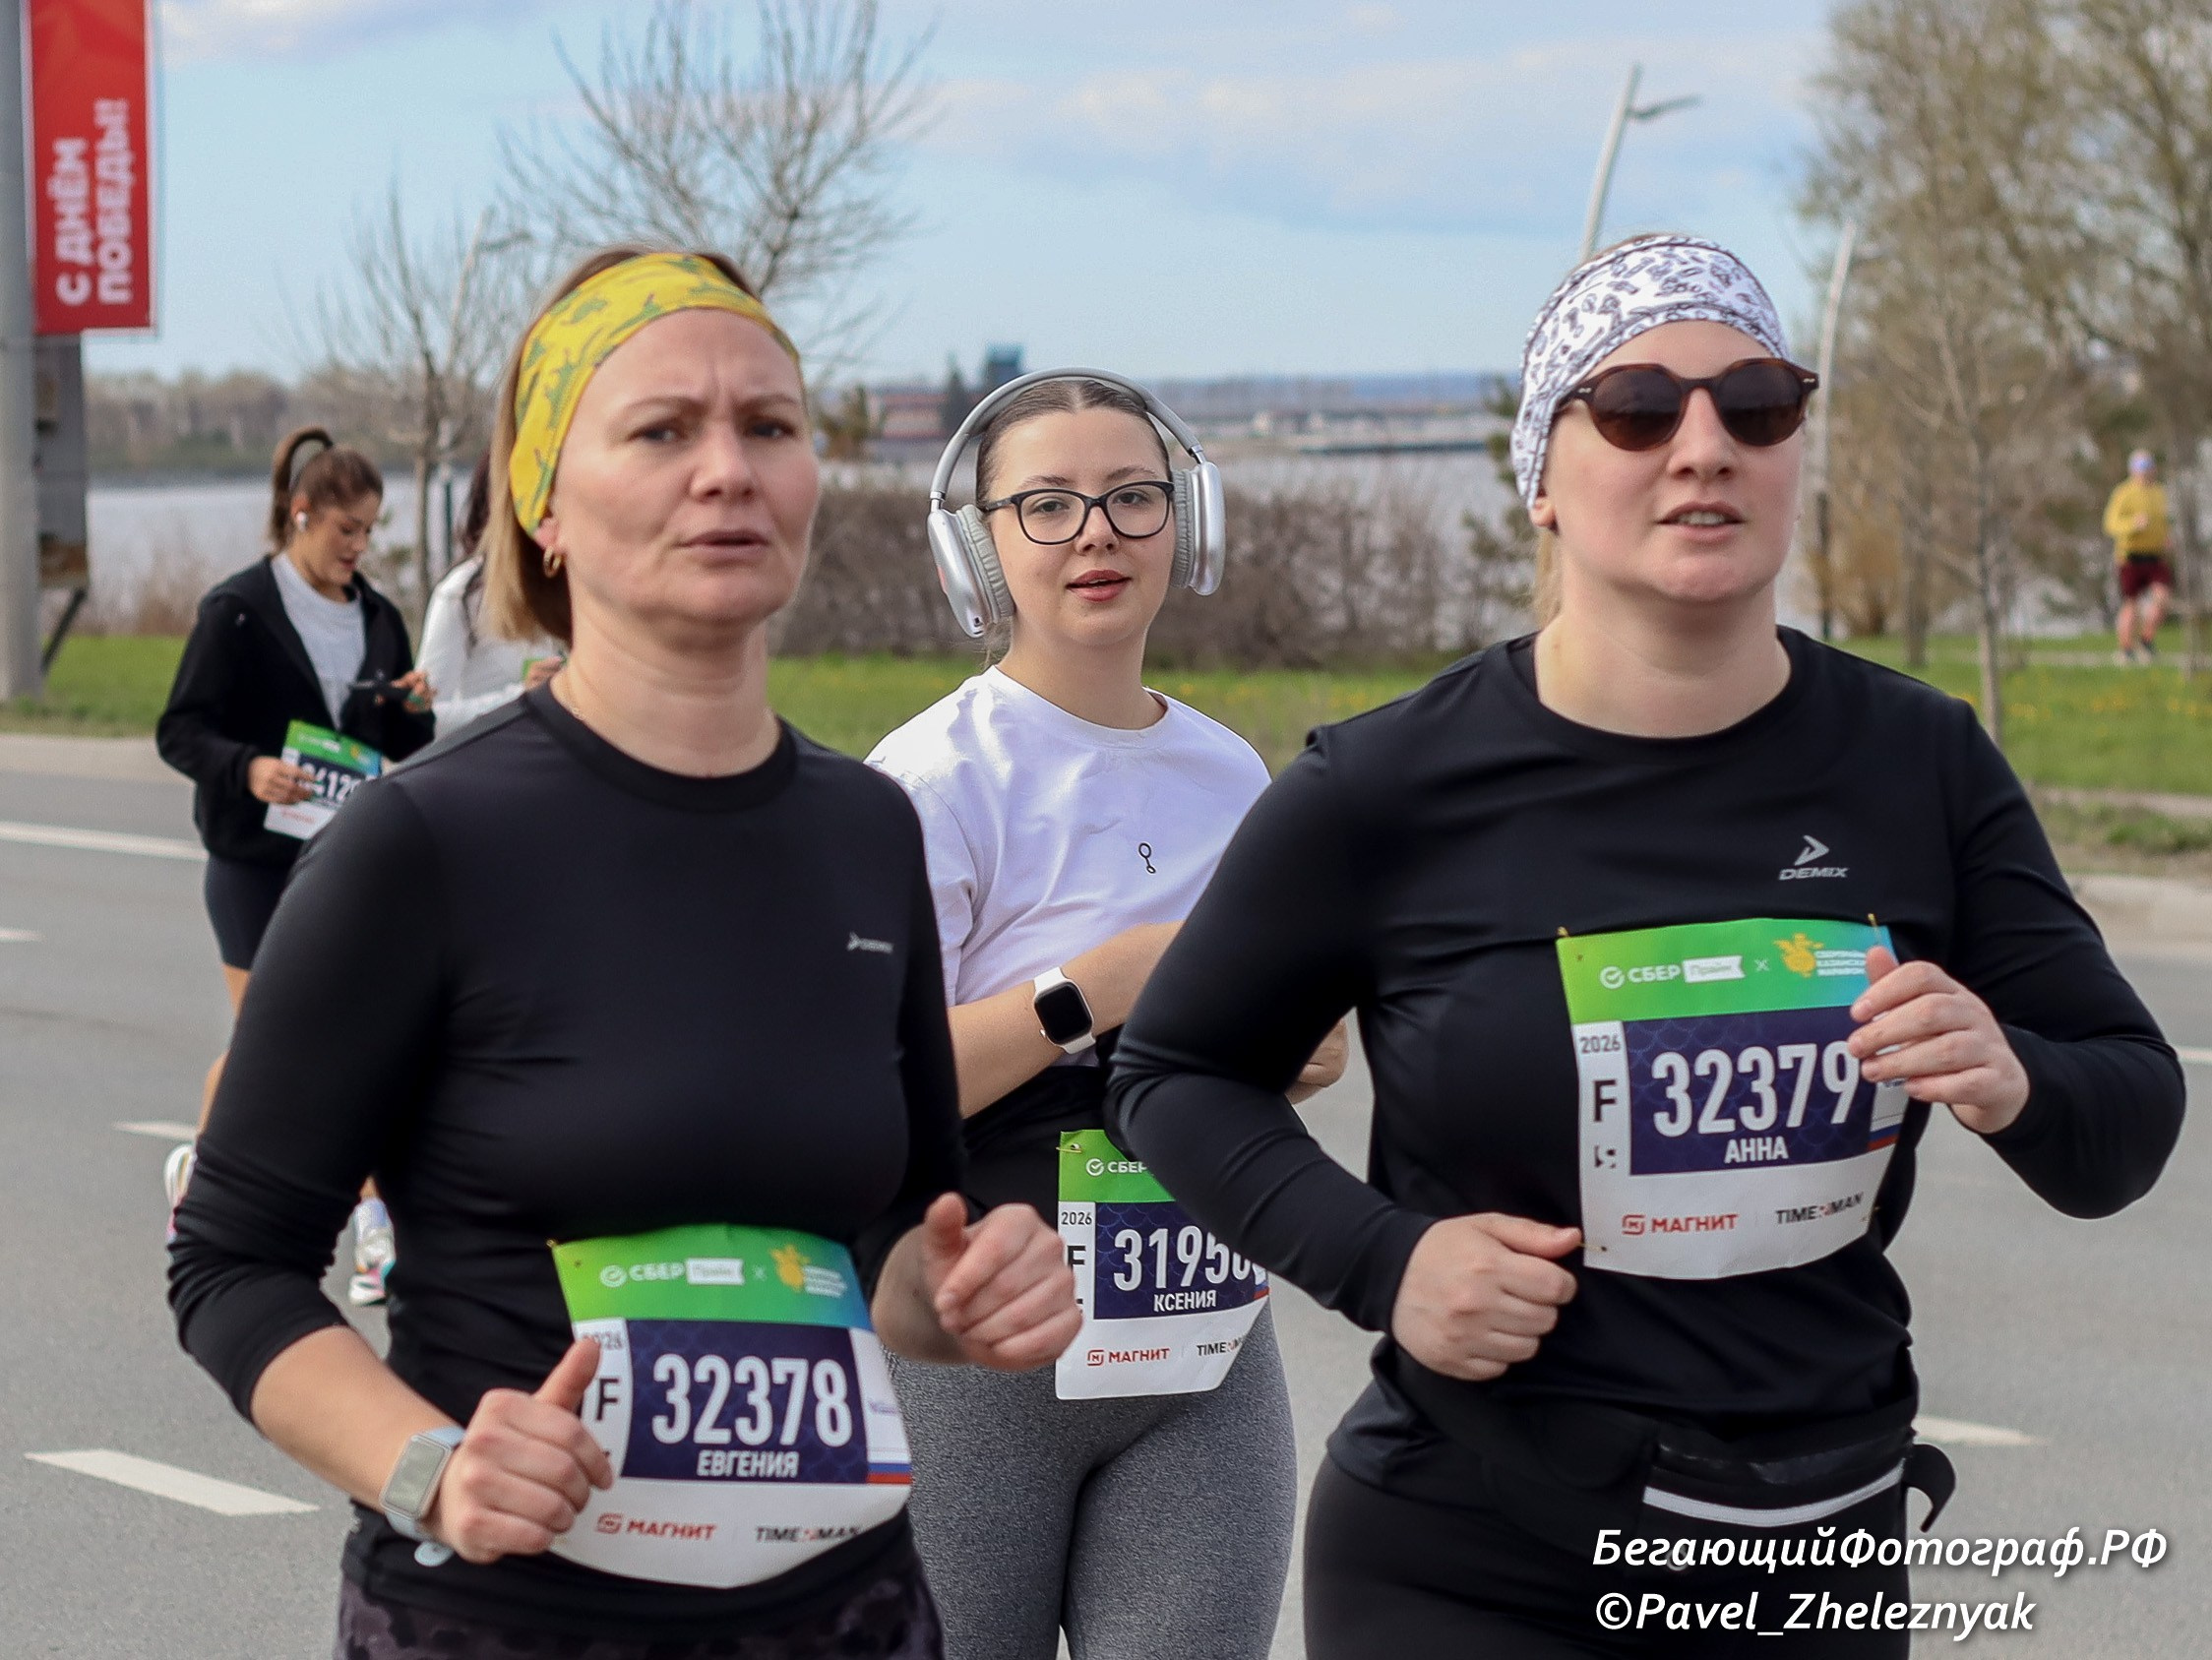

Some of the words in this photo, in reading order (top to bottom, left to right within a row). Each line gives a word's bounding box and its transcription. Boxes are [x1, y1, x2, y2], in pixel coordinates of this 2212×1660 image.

[55, 271, 92, 307] С
[1778, 867, 1849, 881] DEMIX
[1627, 963, 1682, 983] СБЕР
[1579, 1034, 1621, 1054] 2026
[1650, 1040, 1862, 1137] 32379
[1593, 1079, 1617, 1123] F
[1724, 1135, 1790, 1164] АННА
[1061, 1211, 1093, 1226] 2026
[1650, 1213, 1740, 1233] МАГНИТ
[629, 1262, 686, 1281] СБЕР
[1153, 1289, 1216, 1313] КСЕНИЯ
[1108, 1348, 1171, 1364] МАГНИТ
[595, 1378, 619, 1421] F
[651, 1353, 852, 1447] 32378
[697, 1449, 800, 1478] ЕВГЕНИЯ
[627, 1519, 717, 1541] МАГНИТ
